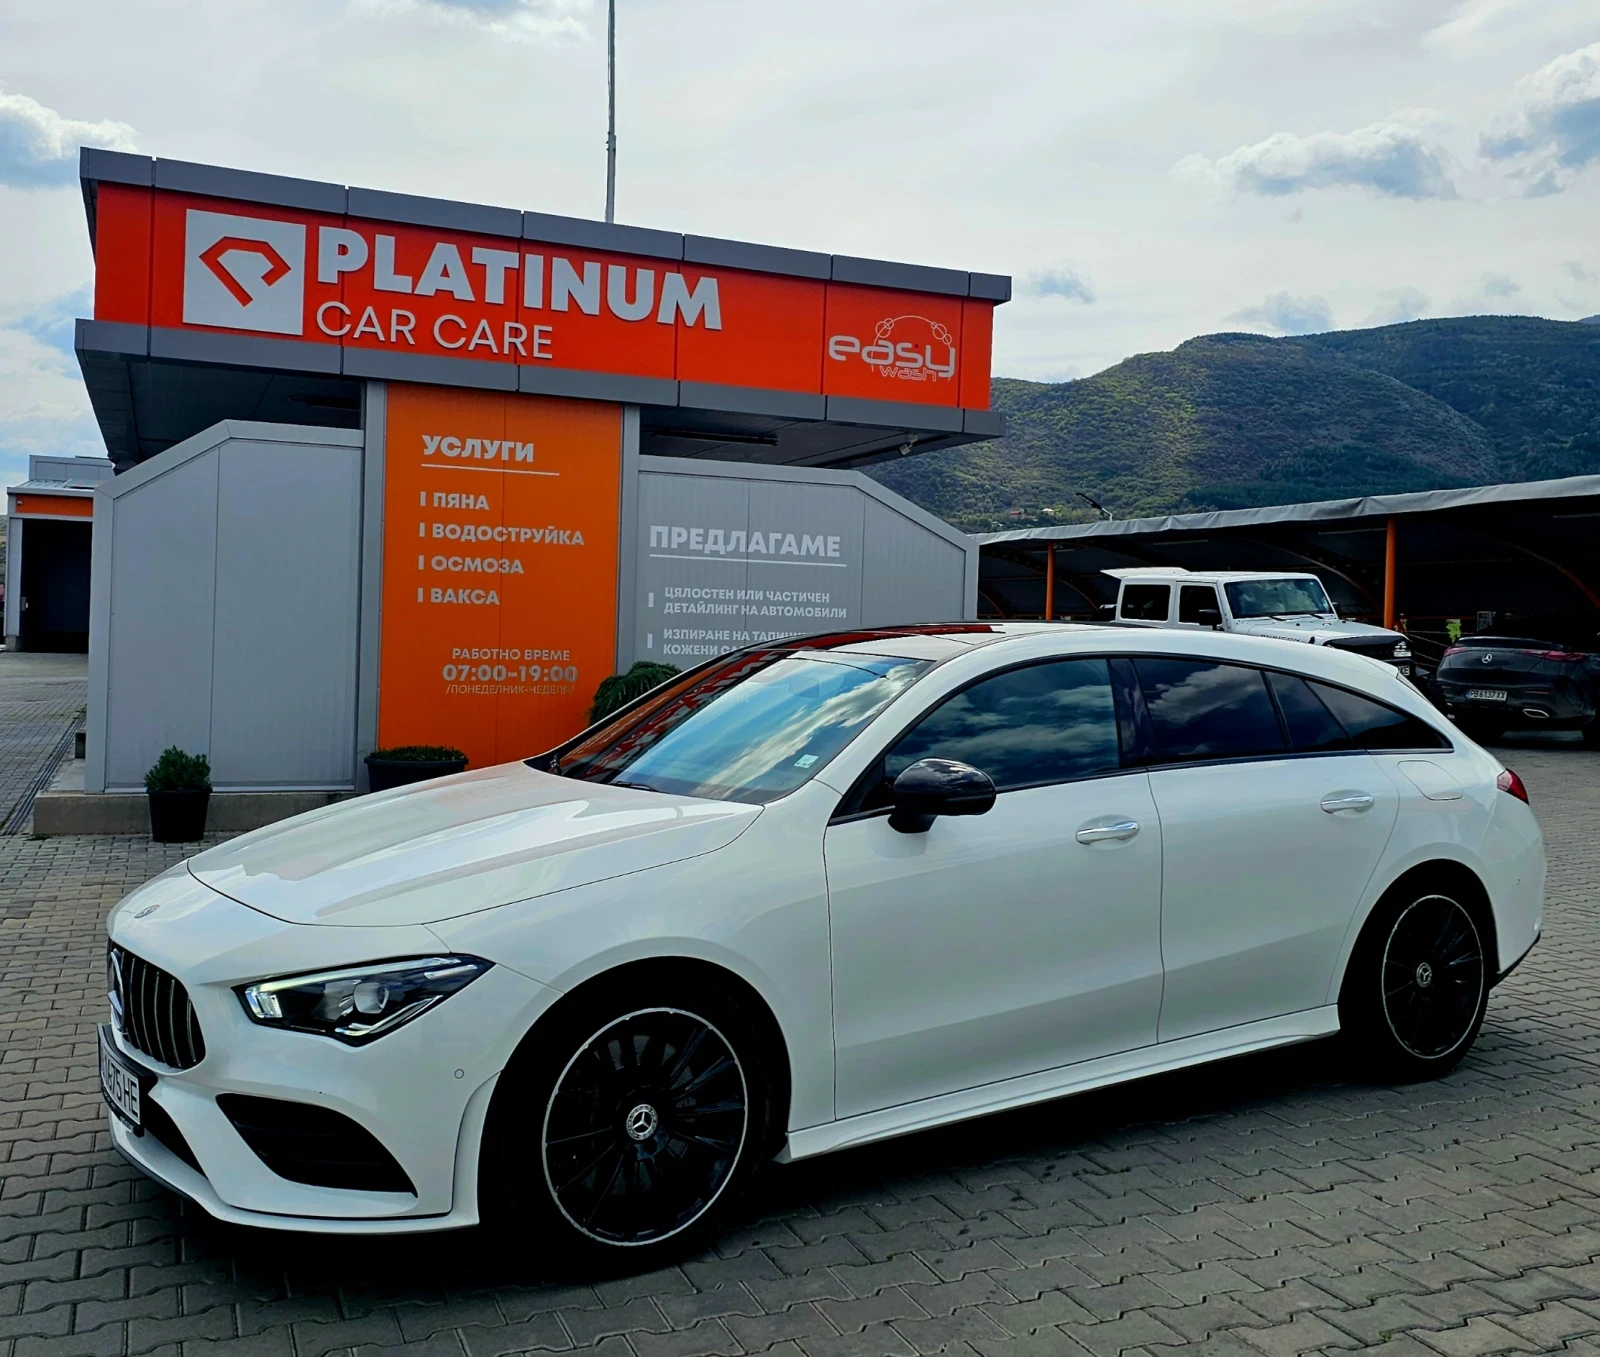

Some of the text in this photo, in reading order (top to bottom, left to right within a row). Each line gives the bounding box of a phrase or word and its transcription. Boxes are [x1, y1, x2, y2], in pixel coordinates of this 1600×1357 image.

[317, 225, 722, 331] PLATINUM
[315, 300, 553, 360] CAR CARE
[829, 335, 956, 377] easy
[879, 365, 936, 382] wash
[421, 434, 534, 463] УСЛУГИ
[433, 492, 490, 510] ПЯНА
[432, 523, 585, 546] ВОДОСТРУЙКА
[649, 525, 841, 558] ПРЕДЛАГАМЕ
[431, 555, 524, 574] ОСМОЗА
[430, 587, 500, 605] ВАКСА
[664, 586, 830, 603] ЦЯЛОСТЕН ИЛИ ЧАСТИЧЕН
[663, 601, 847, 618] ДЕТАЙЛИНГ НА АВТОМОБИЛИ
[663, 628, 731, 641] ИЗПИРАНЕ
[732, 630, 750, 641] НА
[452, 648, 571, 661] РАБОТНО ВРЕМЕ
[663, 643, 718, 656] КОЖЕНИ
[442, 663, 579, 683] 07:00-19:00
